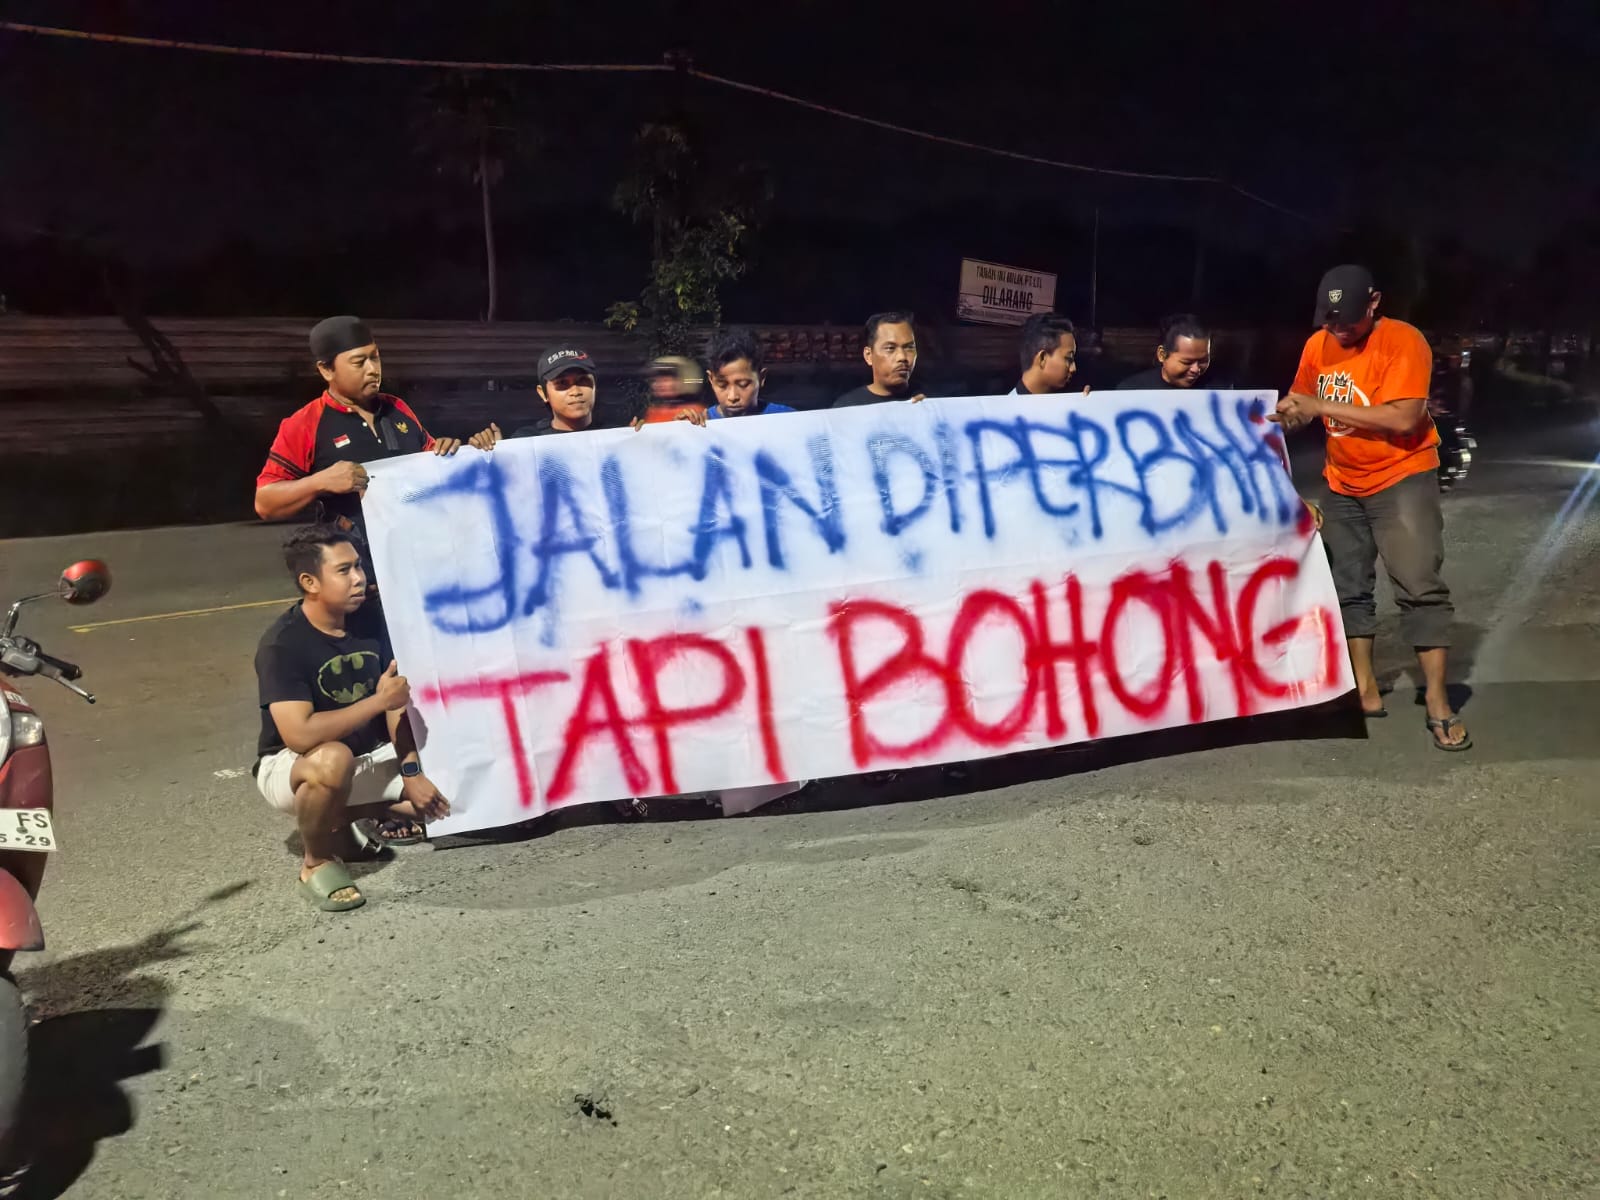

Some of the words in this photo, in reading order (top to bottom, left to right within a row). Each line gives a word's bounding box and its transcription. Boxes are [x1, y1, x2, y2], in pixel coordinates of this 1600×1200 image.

[982, 285, 1033, 311] DILARANG
[402, 436, 848, 640] JALAN
[422, 626, 788, 808] TAPI
[828, 556, 1340, 770] BOHONG
[16, 812, 48, 828] FS
